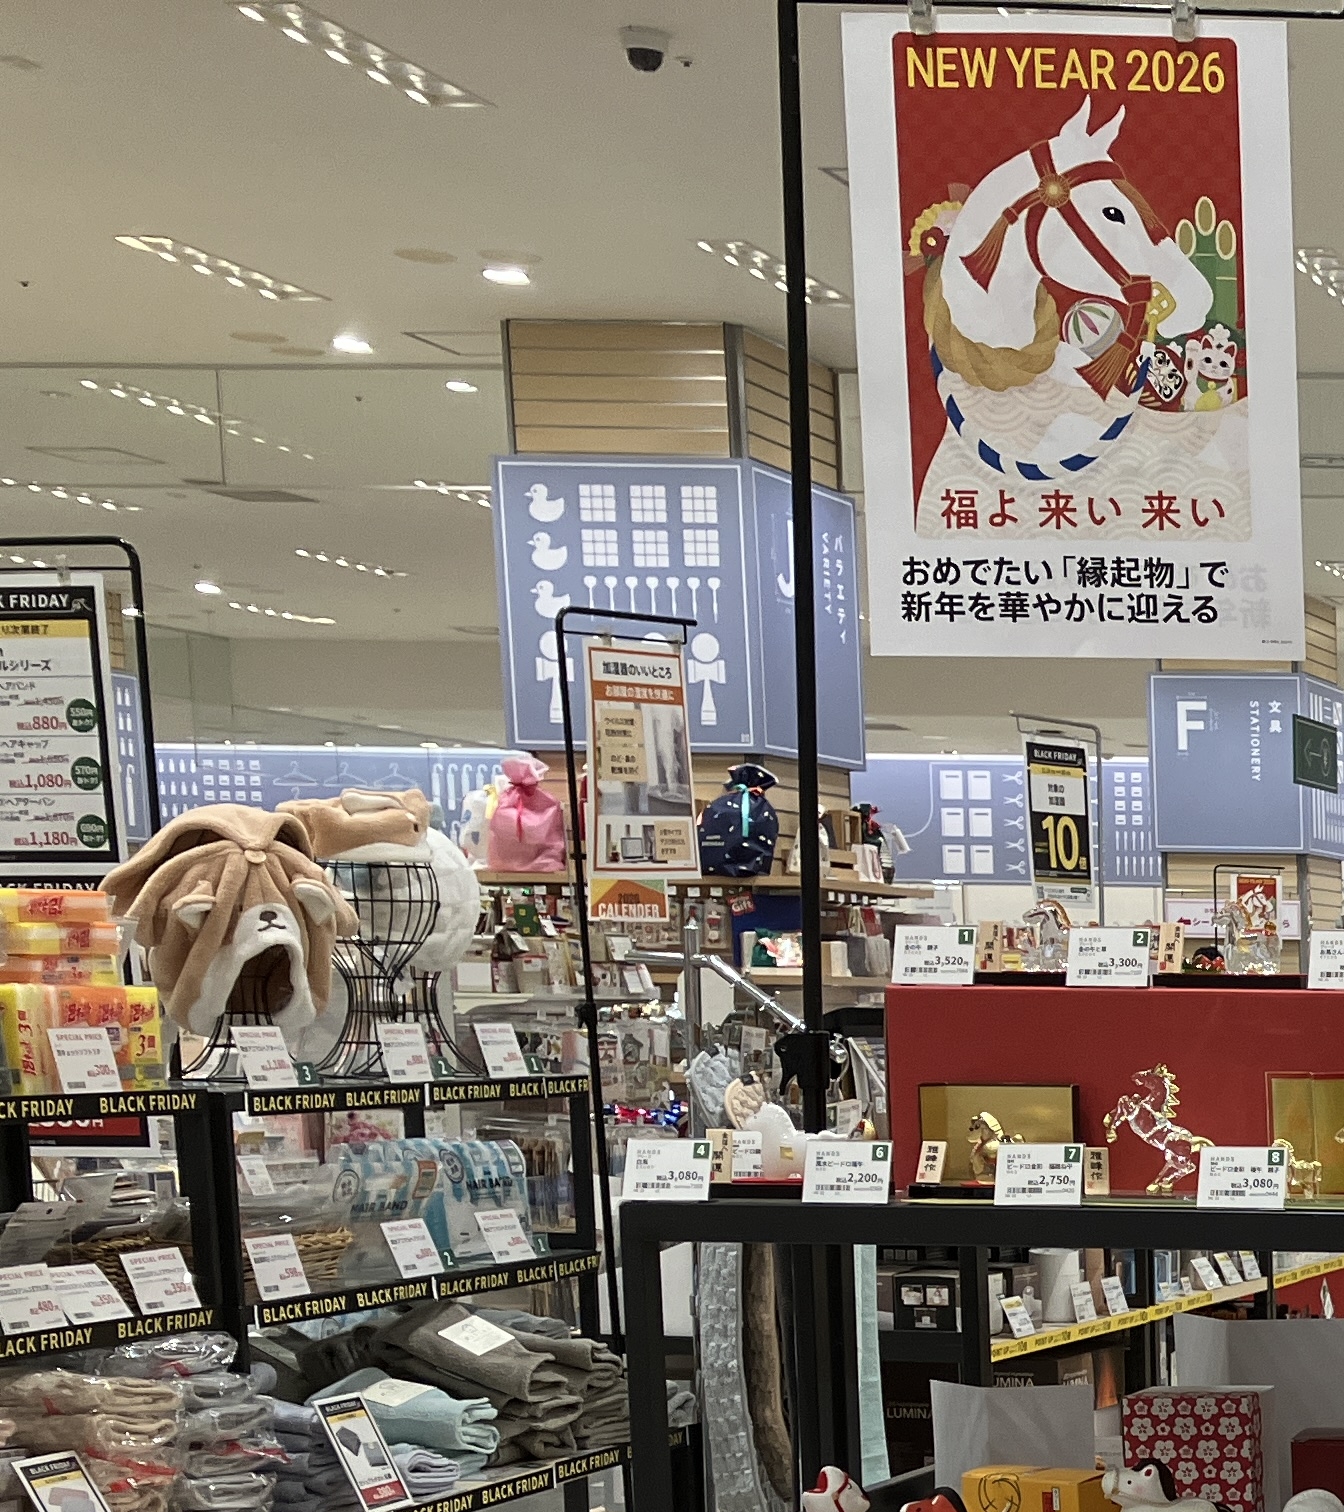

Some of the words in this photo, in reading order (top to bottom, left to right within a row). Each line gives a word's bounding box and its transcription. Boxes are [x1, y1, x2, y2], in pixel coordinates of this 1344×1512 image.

[906, 47, 997, 88] NEW
[1005, 48, 1116, 90] YEAR
[1126, 49, 1225, 92] 2026
[941, 490, 1018, 528] 福よ
[1039, 491, 1121, 529] 来い
[1141, 491, 1225, 529] 来い
[902, 556, 1230, 589] おめでたい「縁起物」で
[10, 594, 69, 608] FRIDAY
[902, 591, 1219, 624] 新年を華やかに迎える
[1176, 701, 1207, 751] F
[1268, 700, 1283, 734] 文具
[1250, 700, 1261, 781] STATIONERY
[1034, 748, 1054, 761] BLACK
[1056, 751, 1077, 763] FRIDAY
[1041, 815, 1080, 870] 10
[598, 903, 659, 918] CALENDER
[963, 932, 969, 941] 1
[100, 1096, 144, 1112] BLACK
[150, 1094, 196, 1111] FRIDAY
[253, 1095, 292, 1111] BLACK
[296, 1093, 335, 1109] FRIDAY
[346, 1092, 381, 1107] BLACK
[384, 1089, 420, 1104] FRIDAY
[433, 1086, 466, 1101] BLACK
[468, 1084, 501, 1098] FRIDAY
[696, 1144, 705, 1155] 4
[1068, 1149, 1076, 1159] 7
[1271, 1152, 1280, 1163] 8
[118, 1317, 163, 1339] BLACK
[166, 1310, 214, 1332] FRIDAY
